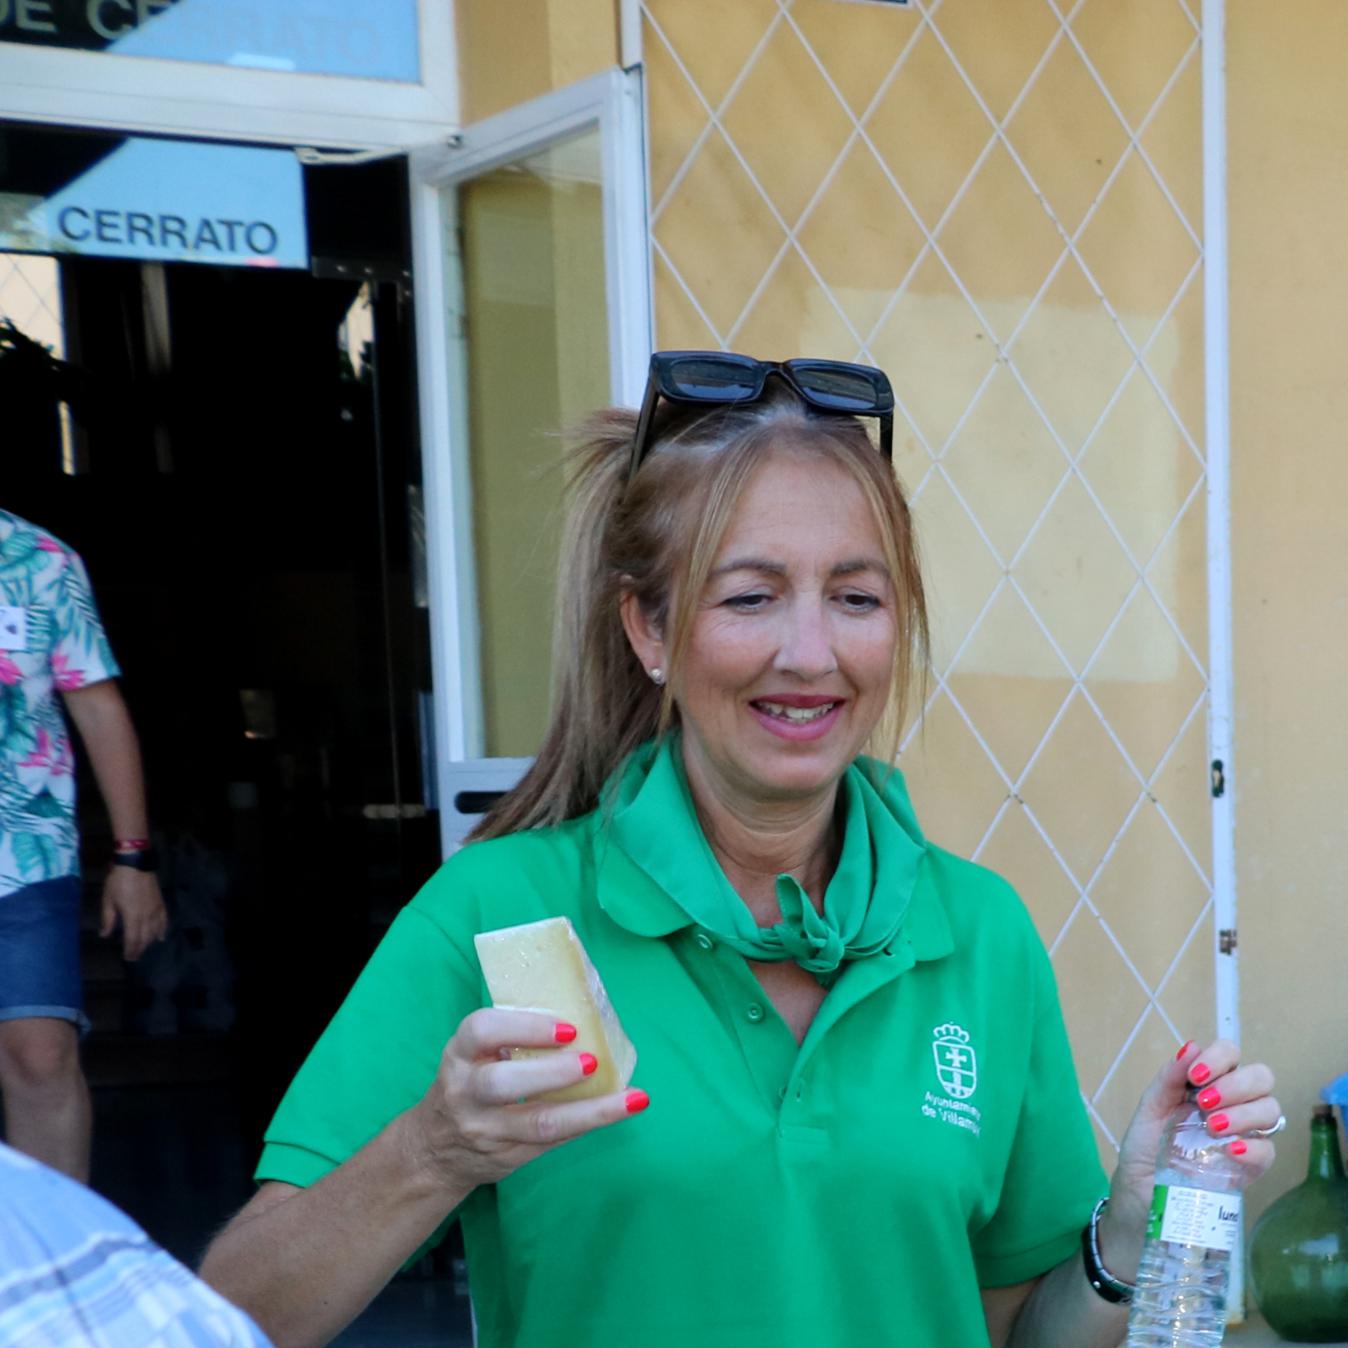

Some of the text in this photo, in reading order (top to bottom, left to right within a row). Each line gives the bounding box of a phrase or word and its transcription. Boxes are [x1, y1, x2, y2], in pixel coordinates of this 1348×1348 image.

[0, 0, 58, 33] E
[58, 206, 278, 255] CERRATO
[921, 1104, 936, 1118] de
